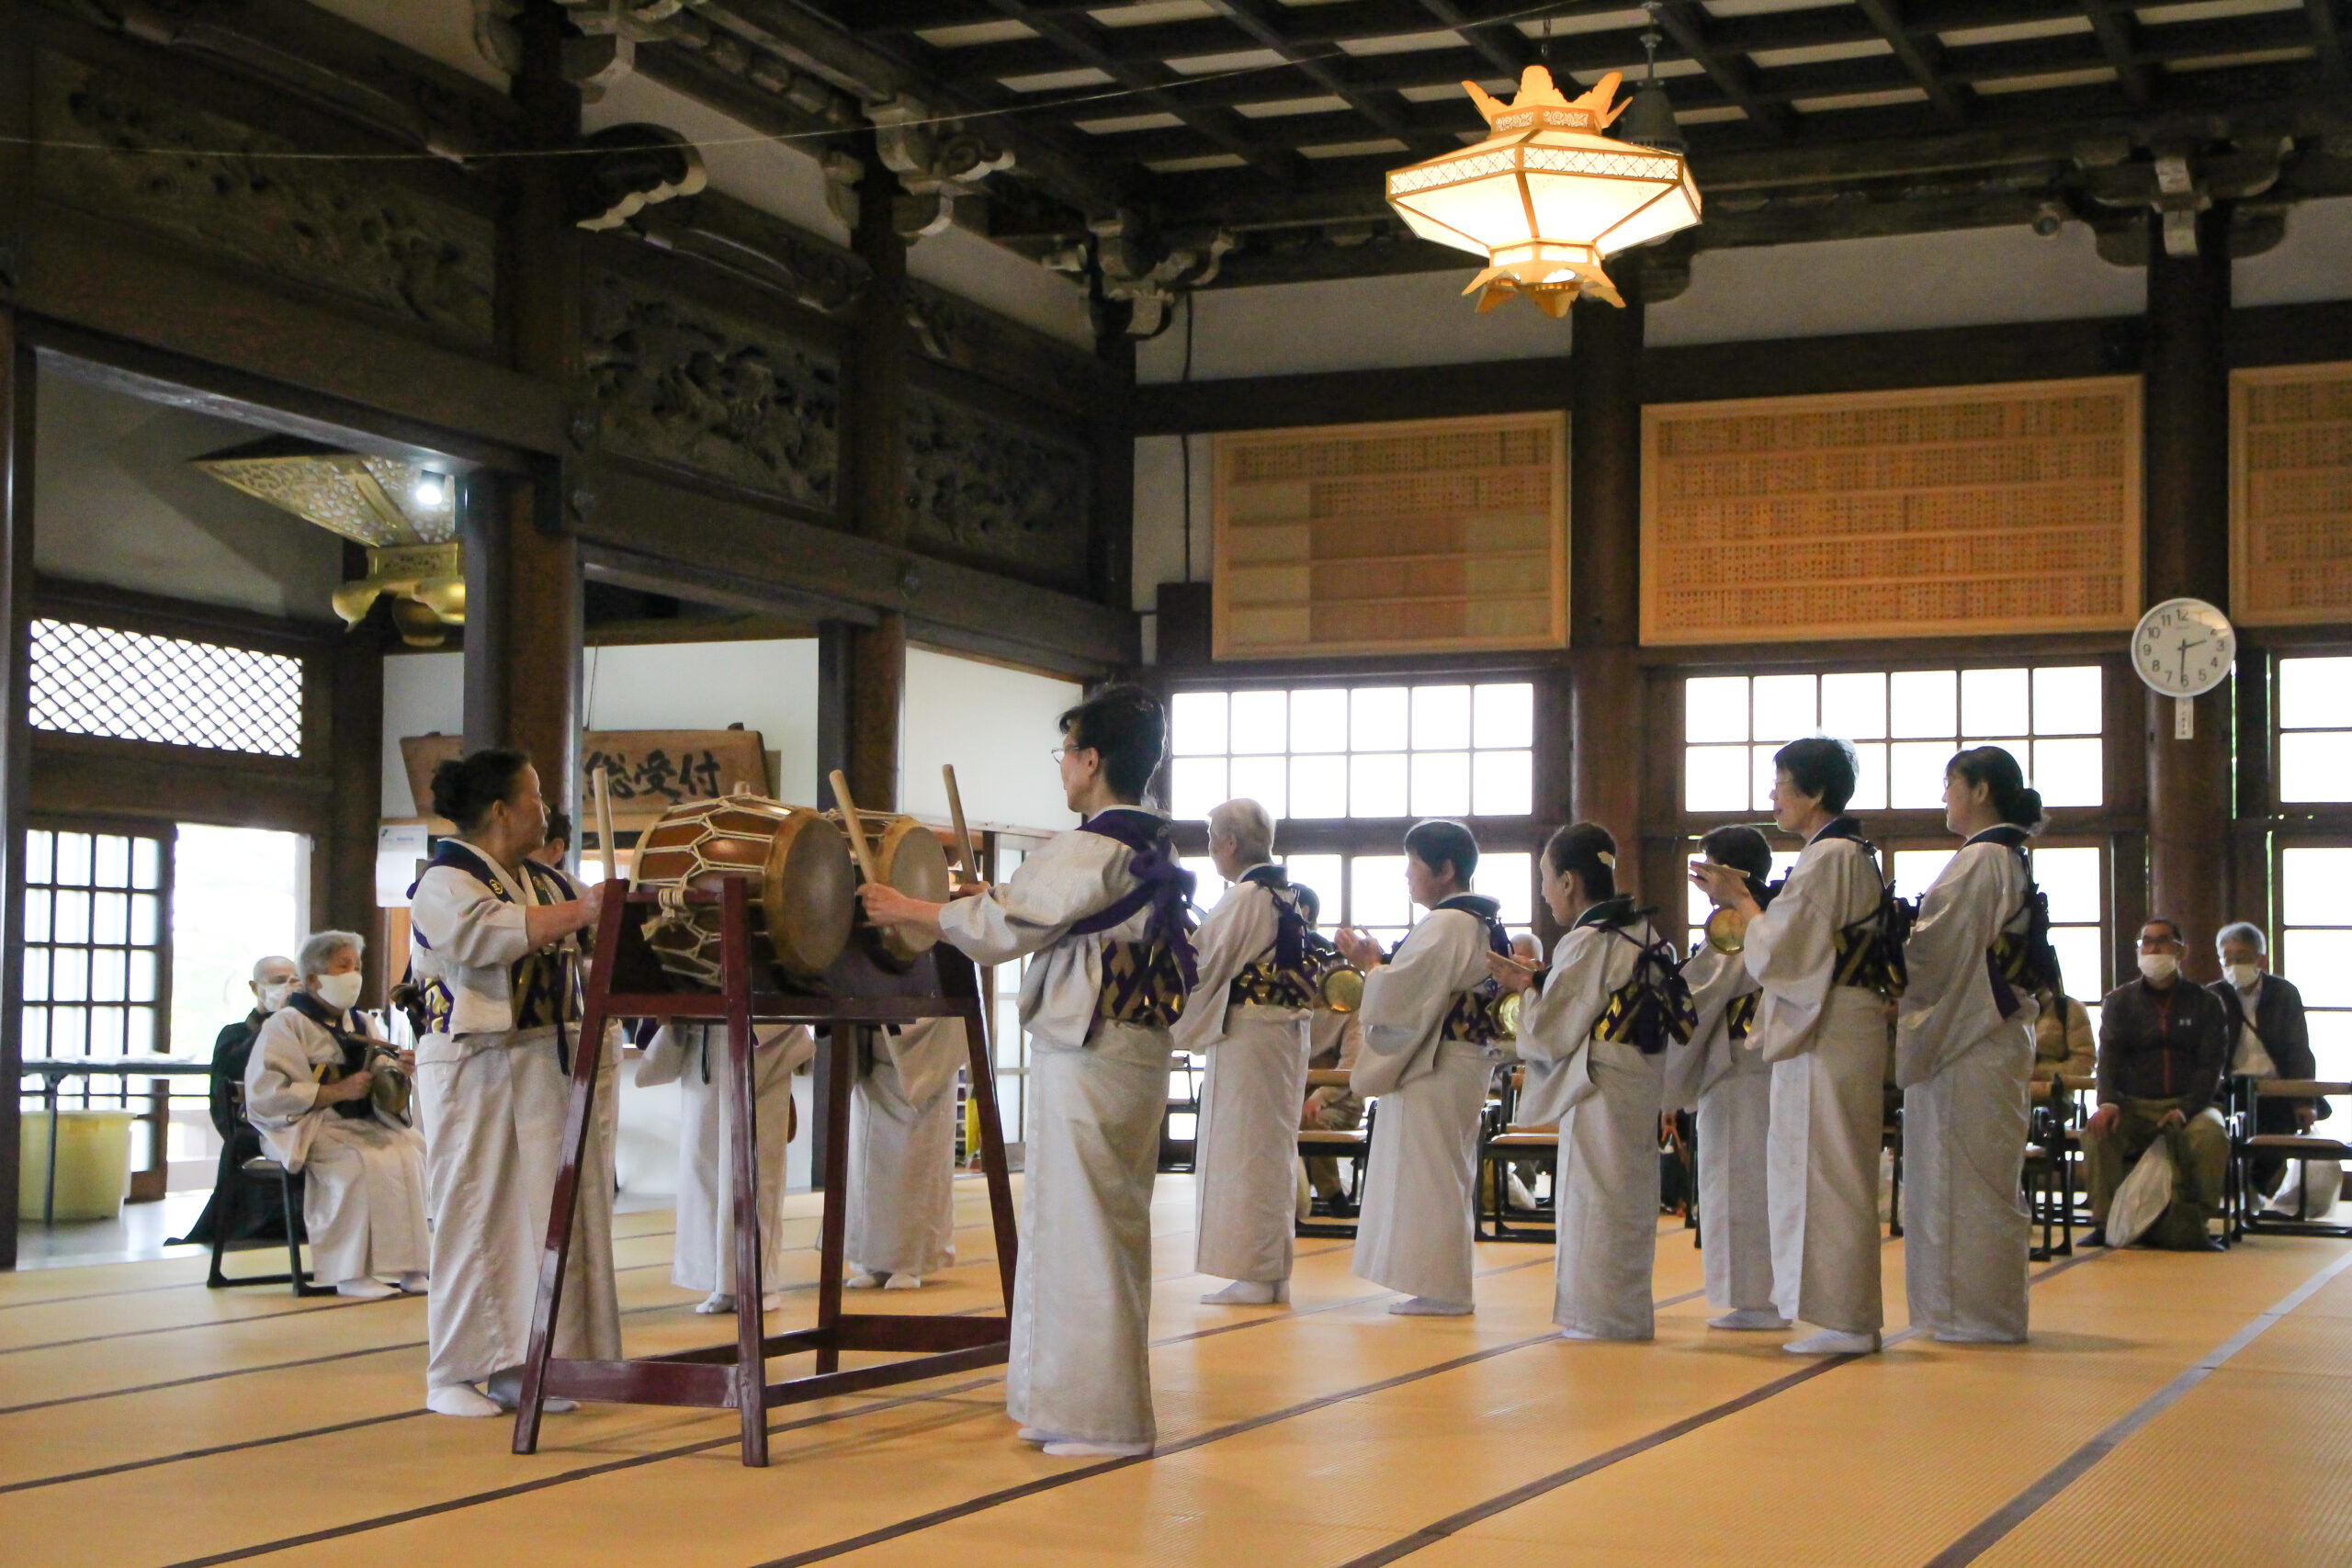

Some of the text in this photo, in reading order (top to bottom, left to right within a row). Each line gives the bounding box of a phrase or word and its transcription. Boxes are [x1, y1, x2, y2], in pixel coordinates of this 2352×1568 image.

[2161, 615, 2172, 626] 11
[2177, 609, 2188, 621] 12
[2148, 626, 2160, 638] 10
[2143, 644, 2151, 656] 9
[2216, 639, 2224, 652] 3
[2152, 660, 2159, 671] 8
[2211, 657, 2217, 669] 4
[2165, 671, 2173, 683] 7
[2199, 669, 2206, 681] 5
